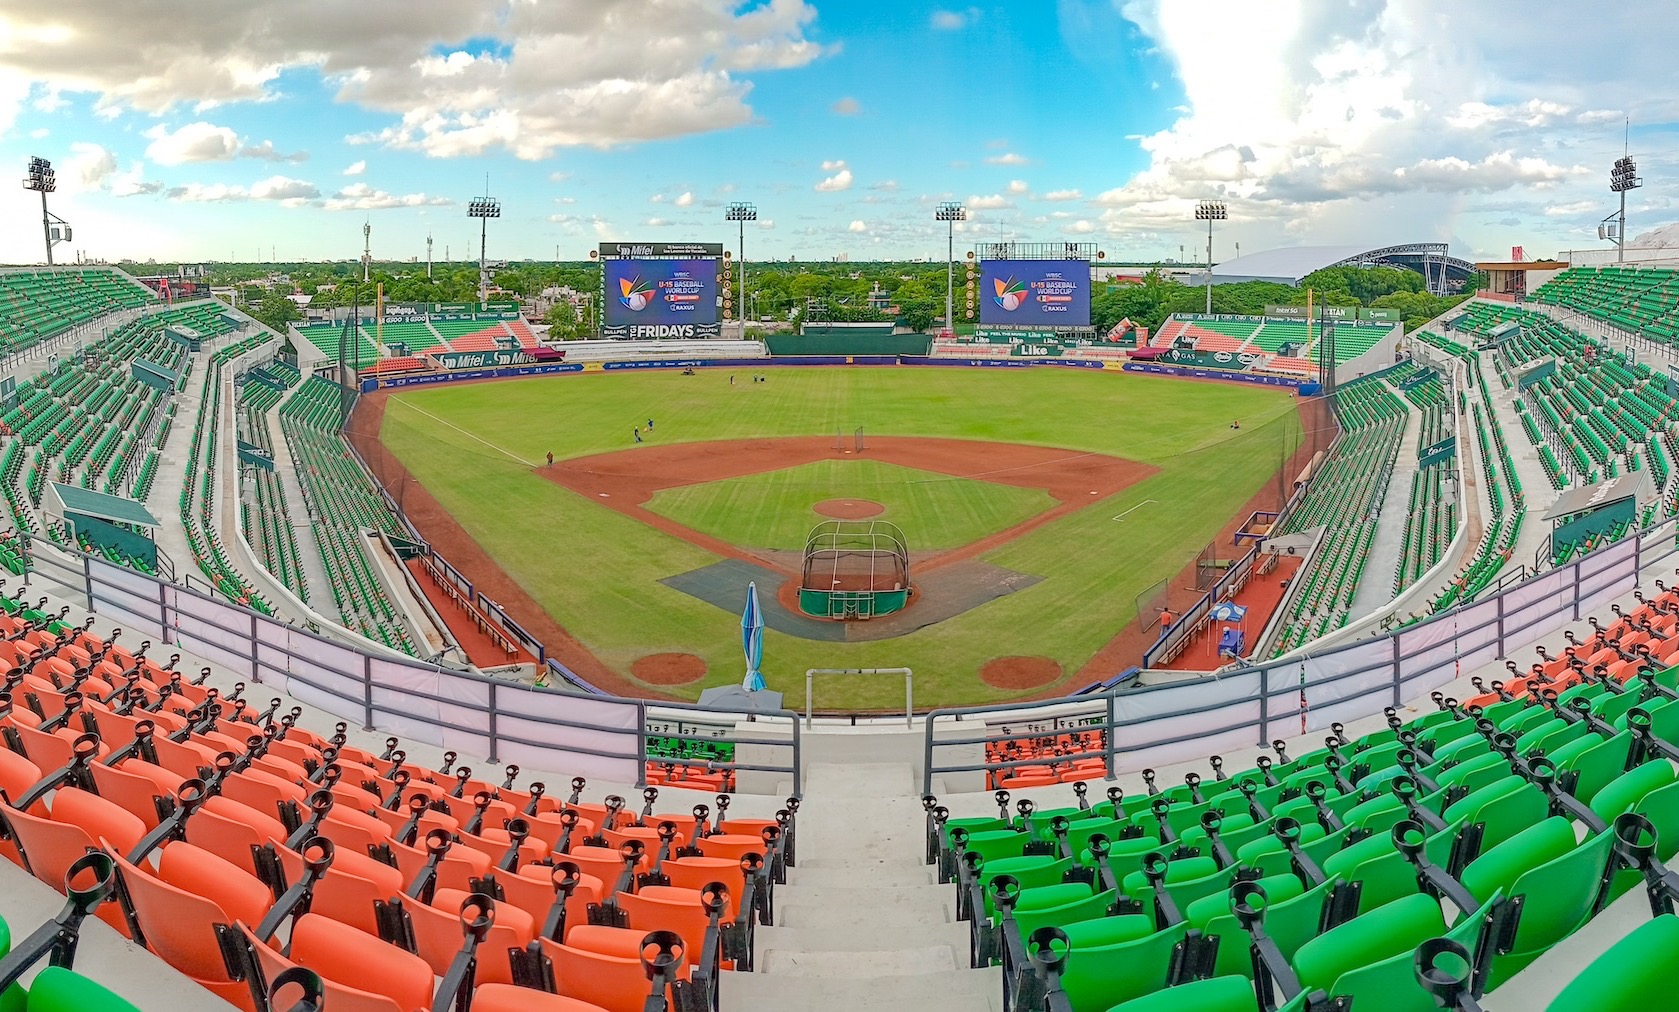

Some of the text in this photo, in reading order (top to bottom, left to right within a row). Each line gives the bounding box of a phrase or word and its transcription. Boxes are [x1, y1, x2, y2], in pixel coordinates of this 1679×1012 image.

[631, 245, 654, 255] Mifel
[638, 324, 694, 338] FRIDAYS
[1021, 345, 1048, 355] Like
[457, 354, 485, 368] Mifel
